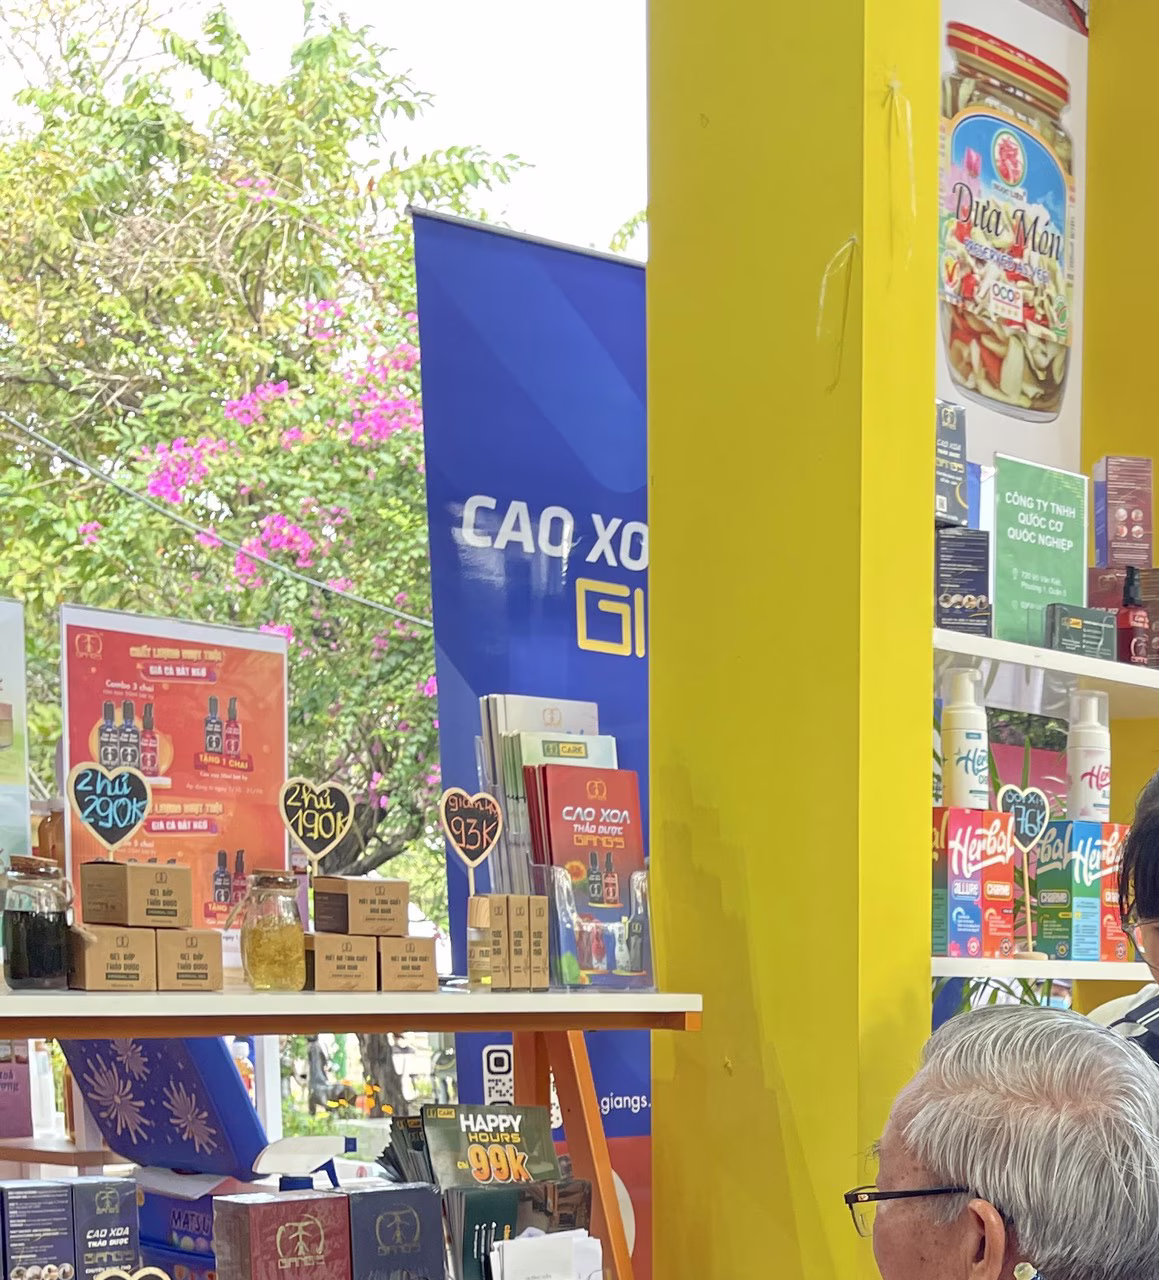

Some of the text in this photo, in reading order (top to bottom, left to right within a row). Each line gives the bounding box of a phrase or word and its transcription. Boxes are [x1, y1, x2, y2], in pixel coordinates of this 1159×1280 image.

[952, 182, 1061, 261] Dưa Món
[992, 282, 1021, 303] OCOP
[1005, 490, 1076, 518] CÔNG TY TNHH
[462, 494, 649, 572] CAO XO
[1038, 533, 1074, 553] NGHIỆP
[106, 680, 130, 691] Combo
[139, 683, 154, 693] chai
[228, 759, 249, 770] CHAI
[77, 770, 93, 790] 2
[287, 784, 302, 806] 2
[562, 806, 631, 825] CAO XOA
[948, 814, 1015, 879] Herbal
[459, 1113, 522, 1133] HAPPY
[468, 1132, 521, 1143] HOURS
[468, 1143, 534, 1184] 99k
[86, 1228, 108, 1239] CAO
